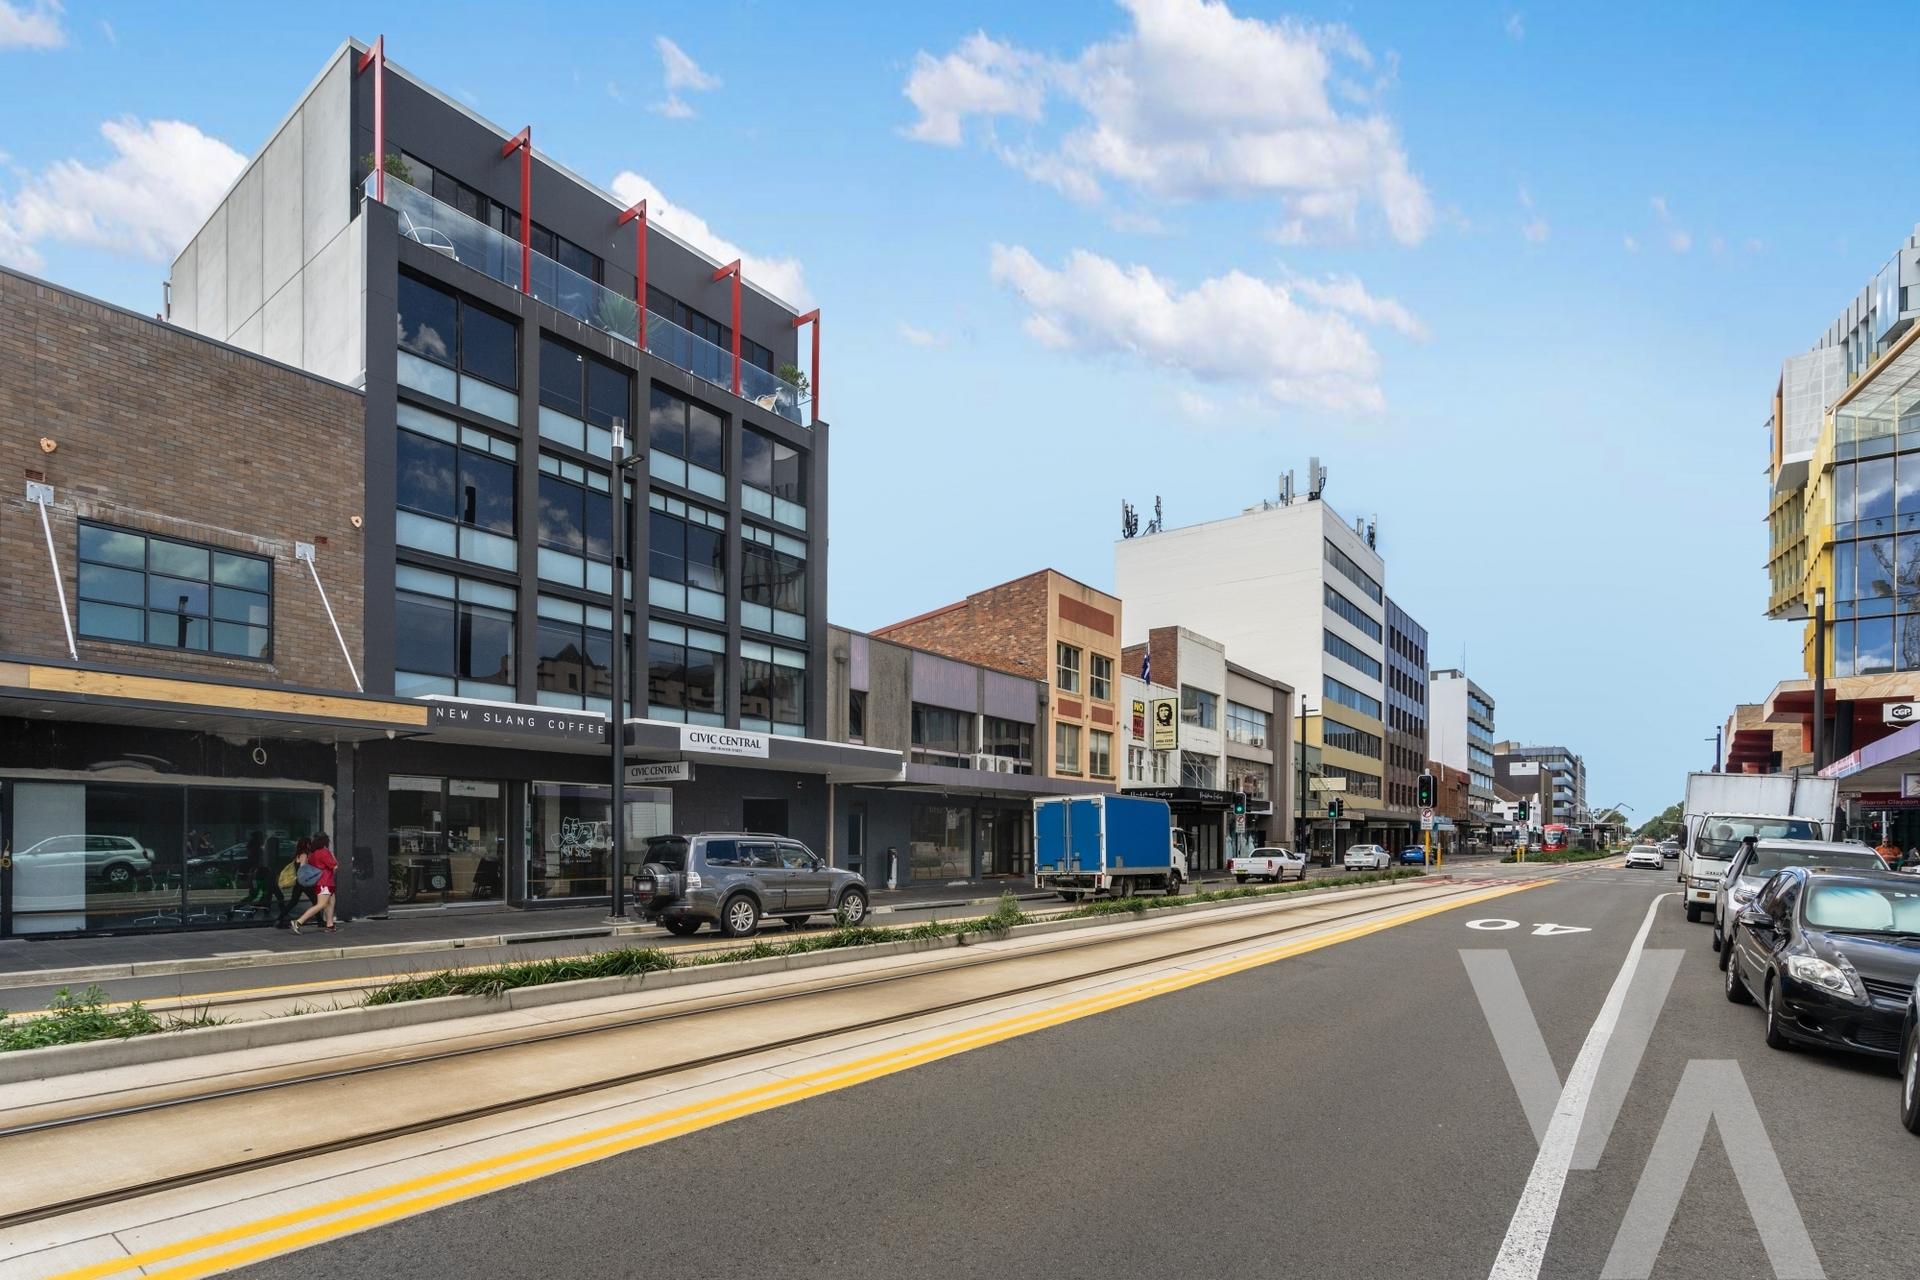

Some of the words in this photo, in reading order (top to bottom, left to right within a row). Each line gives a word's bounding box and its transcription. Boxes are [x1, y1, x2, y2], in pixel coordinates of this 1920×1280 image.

[436, 707, 469, 720] NEW
[483, 712, 535, 727] SLANG
[548, 719, 604, 734] COFFEE
[689, 732, 718, 744] CIVIC
[719, 735, 762, 749] CENTRAL
[631, 766, 650, 777] CIVIC
[650, 764, 681, 776] CENTRAL
